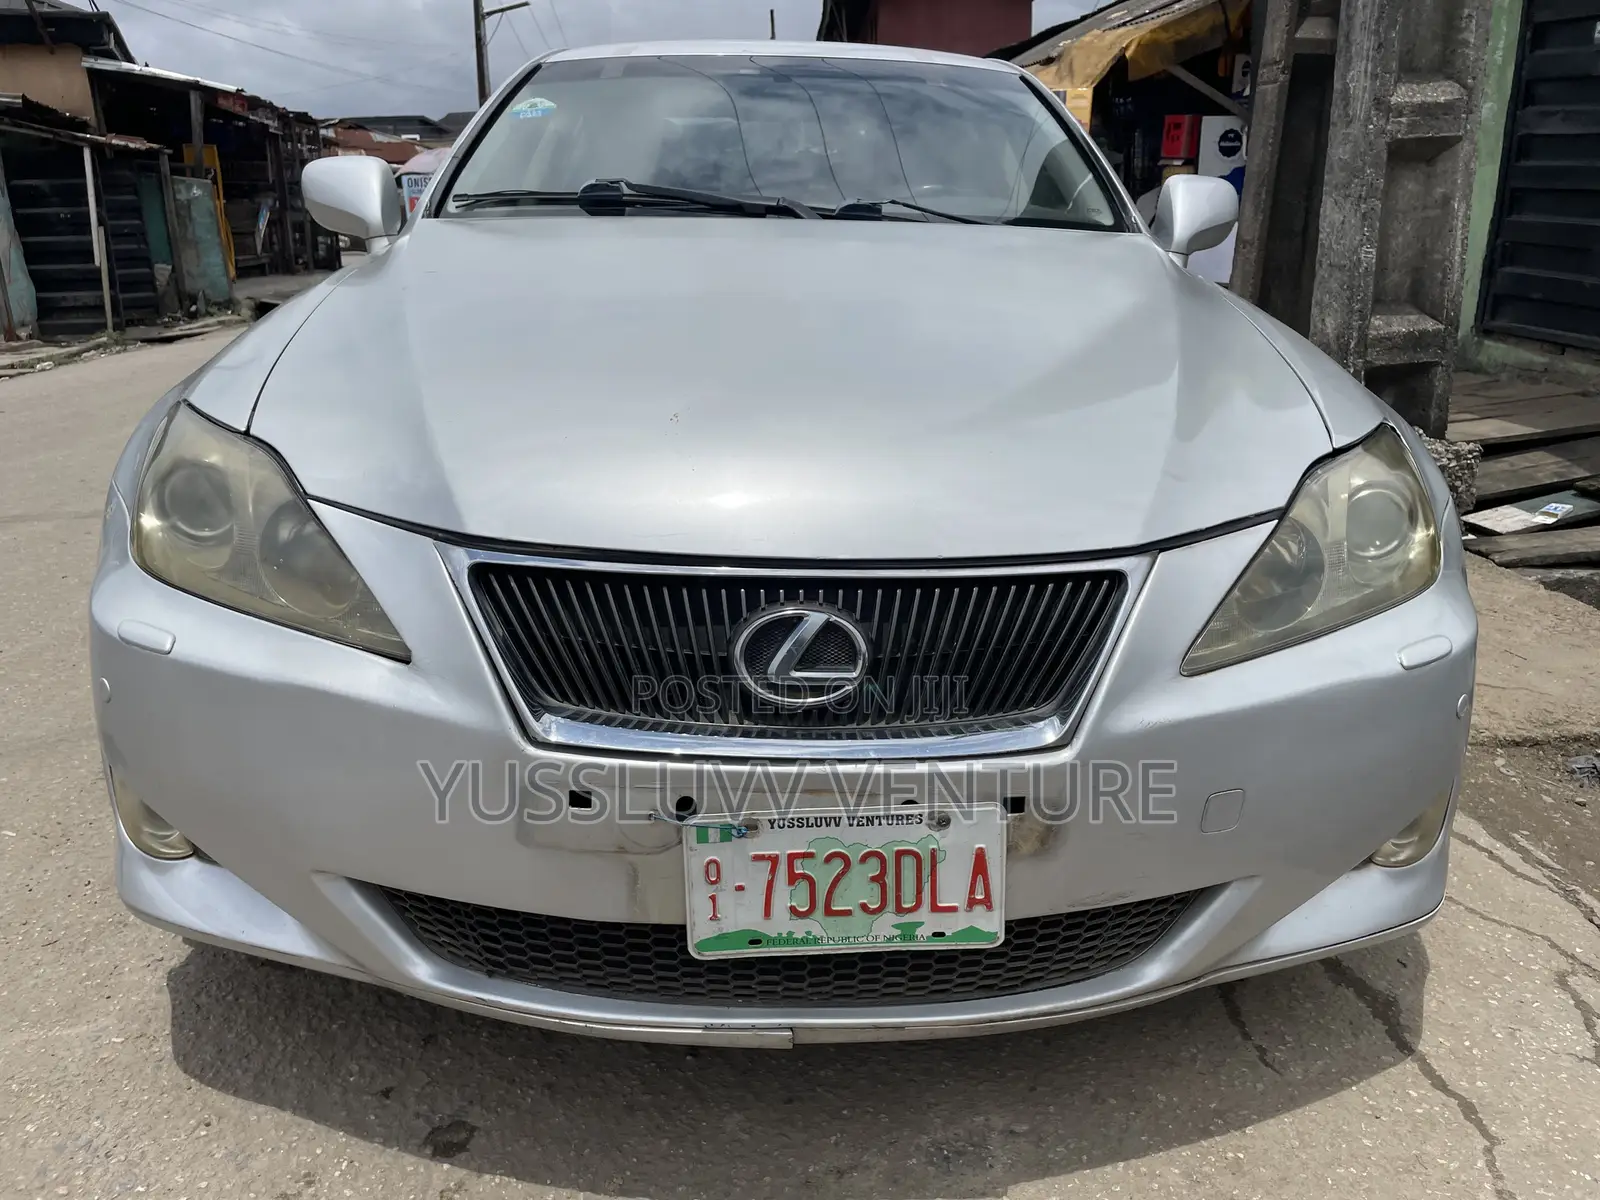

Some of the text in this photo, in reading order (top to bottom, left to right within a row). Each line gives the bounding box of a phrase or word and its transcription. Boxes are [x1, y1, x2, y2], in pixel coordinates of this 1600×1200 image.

[407, 176, 432, 188] ONIS
[846, 813, 924, 827] VENTURES
[766, 933, 927, 946] FEDERAL REPUBLIC OF NIGERIA
